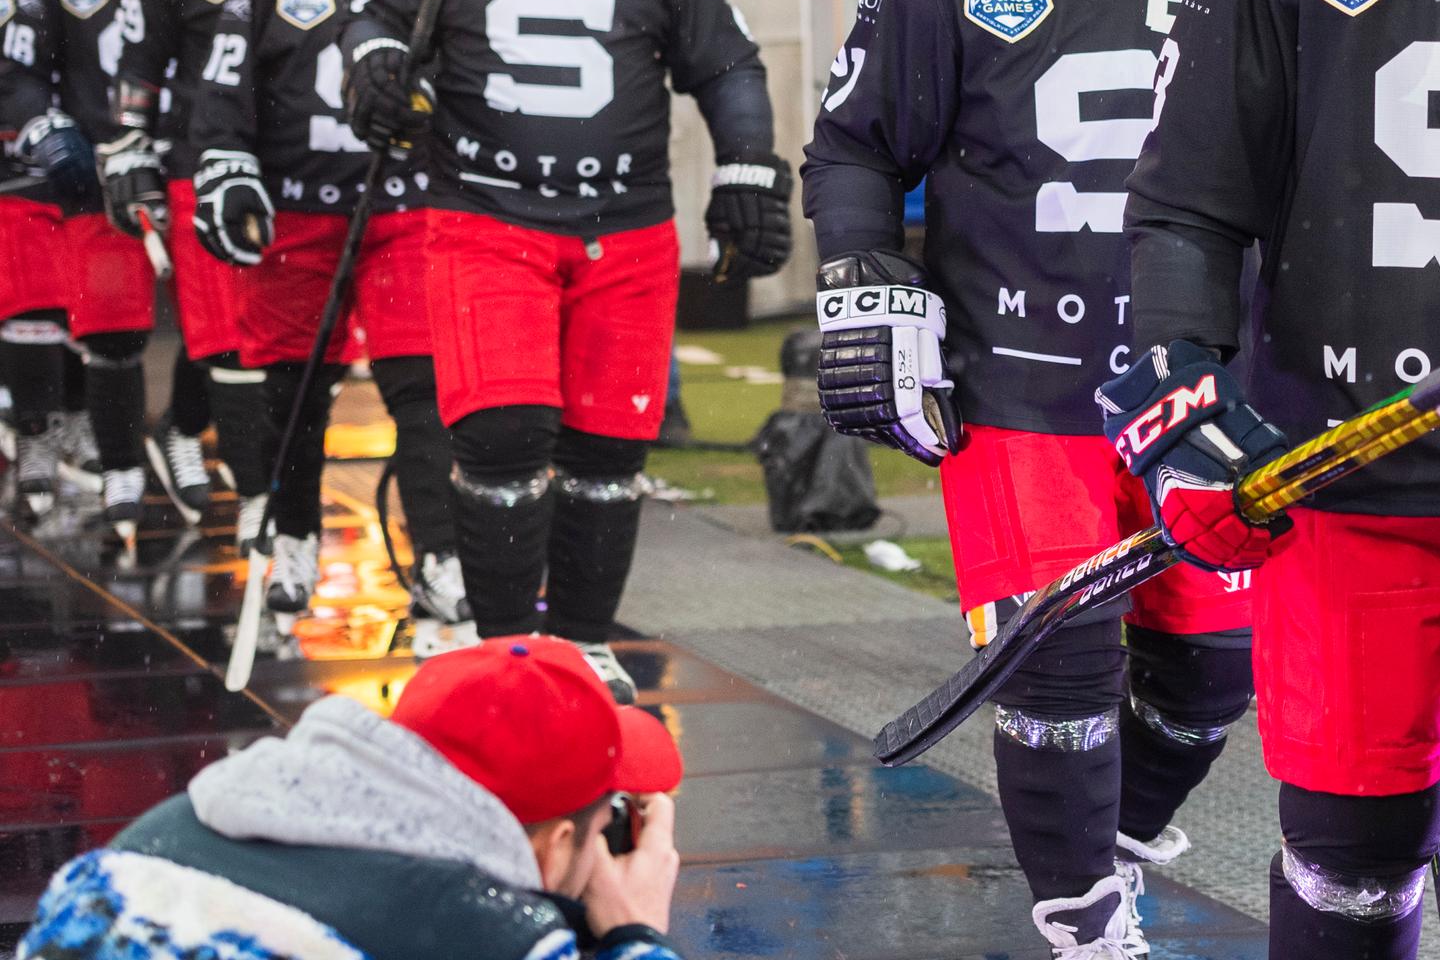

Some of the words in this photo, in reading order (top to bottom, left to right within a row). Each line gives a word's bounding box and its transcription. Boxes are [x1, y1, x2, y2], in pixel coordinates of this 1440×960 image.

[983, 3, 1034, 13] GAMES
[203, 33, 247, 86] 12
[456, 137, 632, 178] MOTOR
[823, 290, 926, 318] CCM
[997, 287, 1131, 325] MOT
[1115, 374, 1218, 468] CCM
